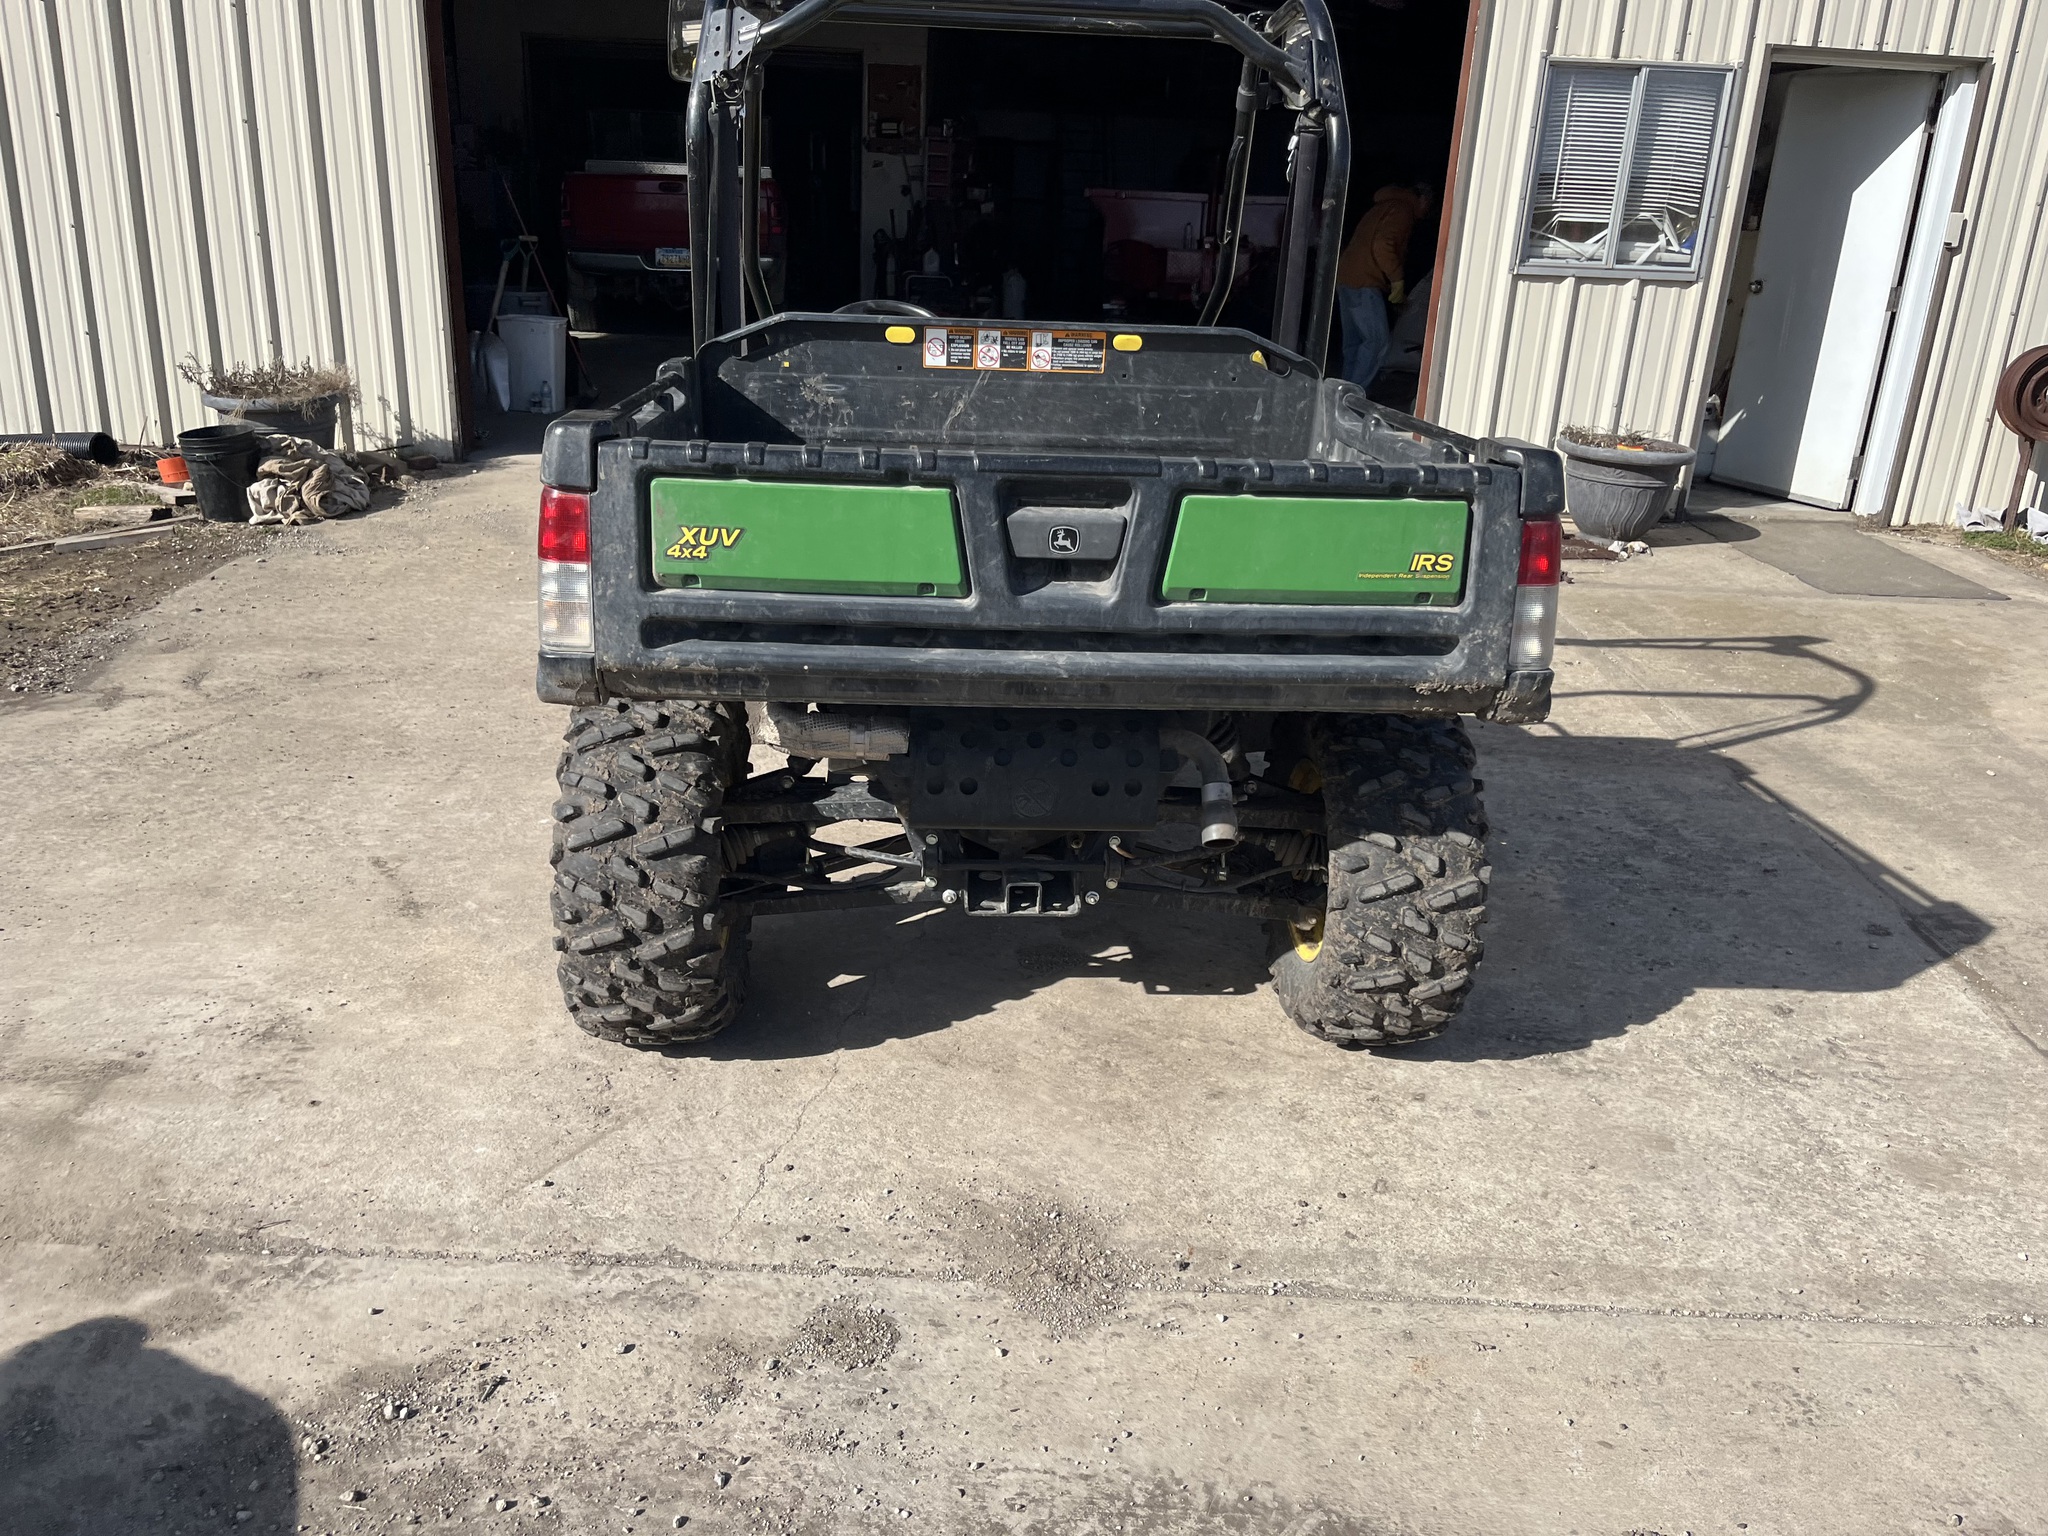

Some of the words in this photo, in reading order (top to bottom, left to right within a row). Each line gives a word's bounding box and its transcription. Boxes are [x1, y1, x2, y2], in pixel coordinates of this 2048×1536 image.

[677, 526, 741, 546] XUV
[666, 544, 707, 559] 4x4
[1410, 553, 1454, 572] IRS
